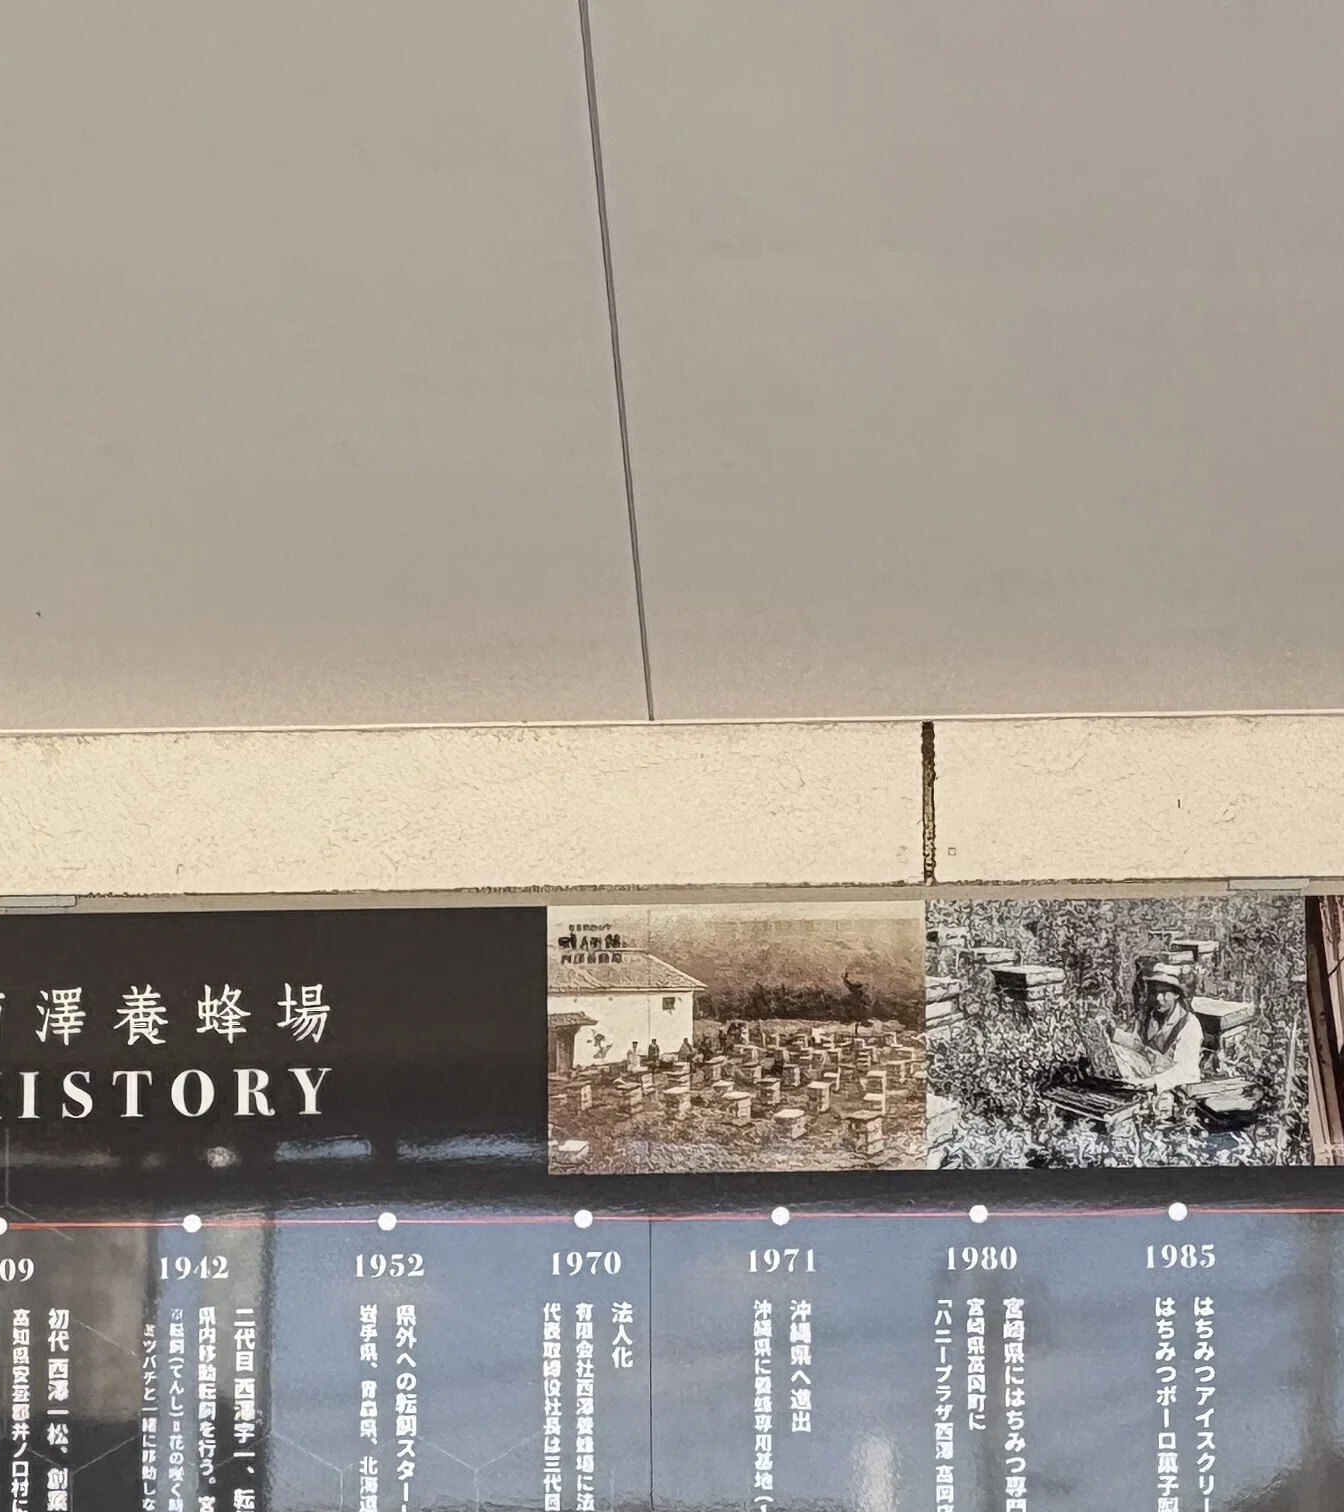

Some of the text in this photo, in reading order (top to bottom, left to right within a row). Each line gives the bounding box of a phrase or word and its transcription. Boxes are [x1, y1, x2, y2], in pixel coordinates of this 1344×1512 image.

[160, 1255, 228, 1279] 1942
[356, 1253, 424, 1277] 1952
[552, 1251, 621, 1275] 1970
[749, 1248, 814, 1272] 1971
[948, 1246, 1017, 1270] 1980
[1146, 1243, 1215, 1268] 1985
[47, 1307, 69, 1352] 初代
[233, 1308, 255, 1371] 二代目
[611, 1301, 633, 1368] 法人化
[789, 1299, 811, 1432] 沖縄県へ進出
